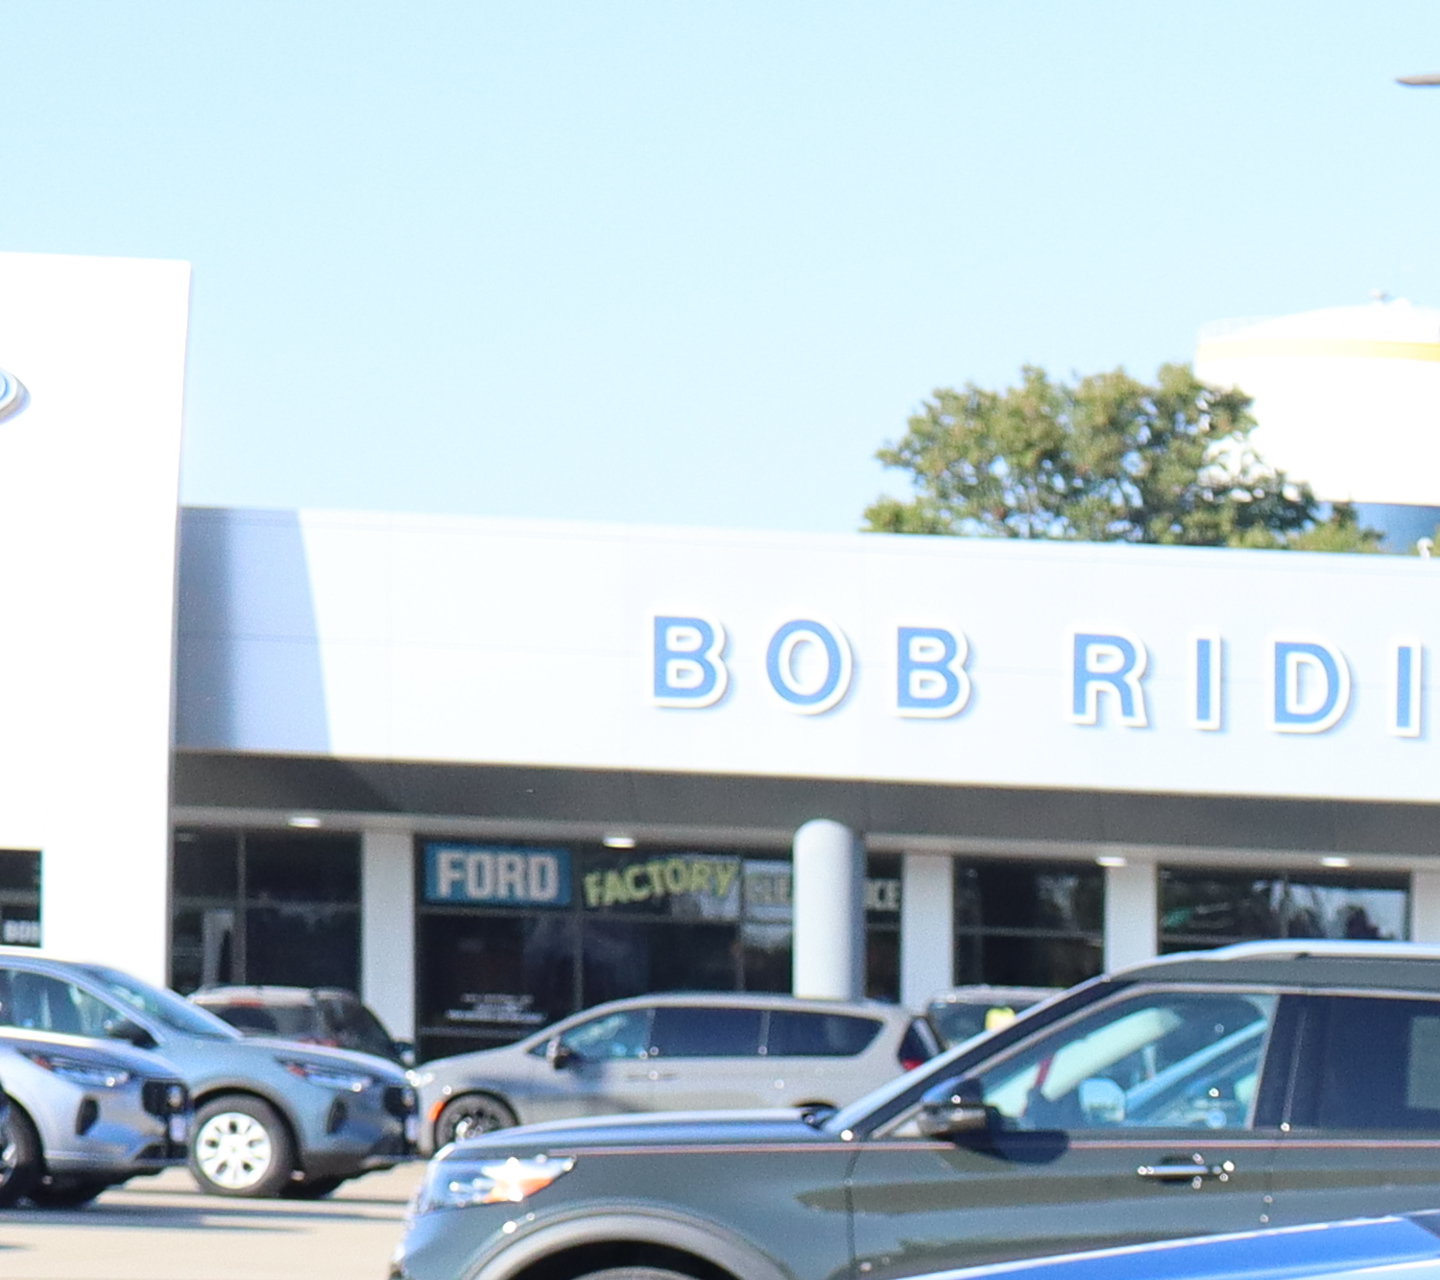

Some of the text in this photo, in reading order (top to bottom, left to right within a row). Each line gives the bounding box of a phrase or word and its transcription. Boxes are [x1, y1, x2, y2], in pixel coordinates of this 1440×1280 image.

[652, 613, 968, 714] BOB
[436, 850, 561, 901] FORD
[584, 857, 739, 908] FACTORY
